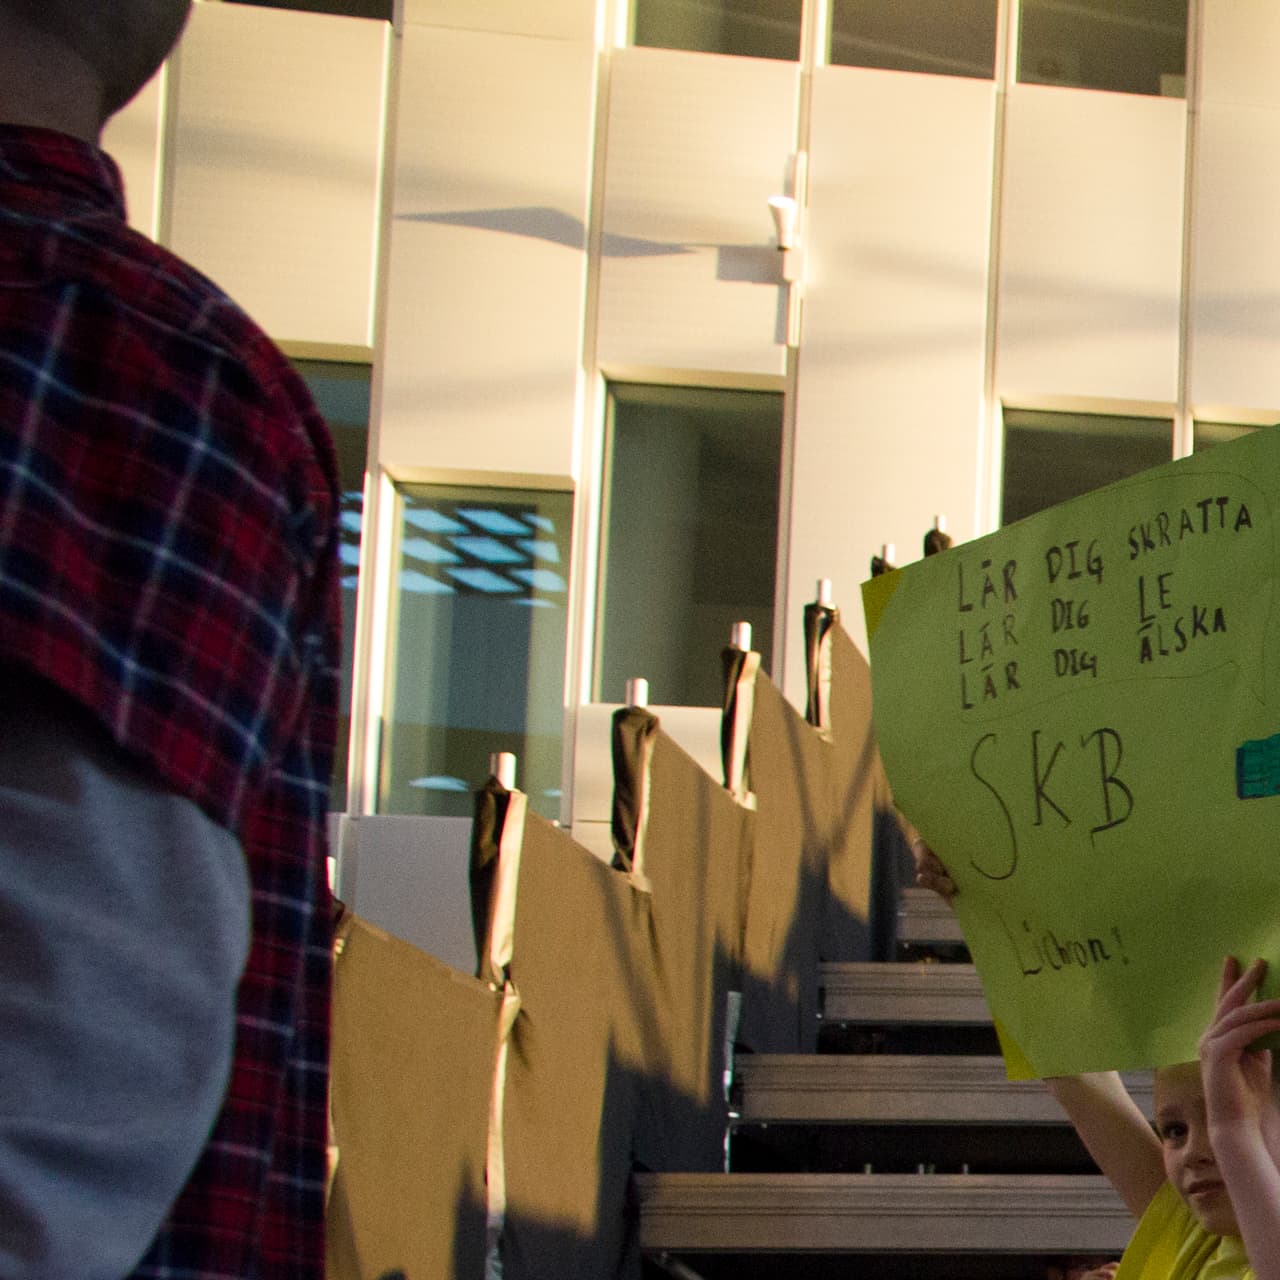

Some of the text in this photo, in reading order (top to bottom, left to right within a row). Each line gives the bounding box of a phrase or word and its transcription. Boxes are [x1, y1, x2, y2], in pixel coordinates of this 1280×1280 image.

[958, 496, 1252, 612] LÄR DIG SKRATTA
[960, 572, 1174, 665] LÄR DIG LE
[962, 606, 1228, 710] LÄR DIG ÄLSKA
[969, 726, 1136, 882] SKB
